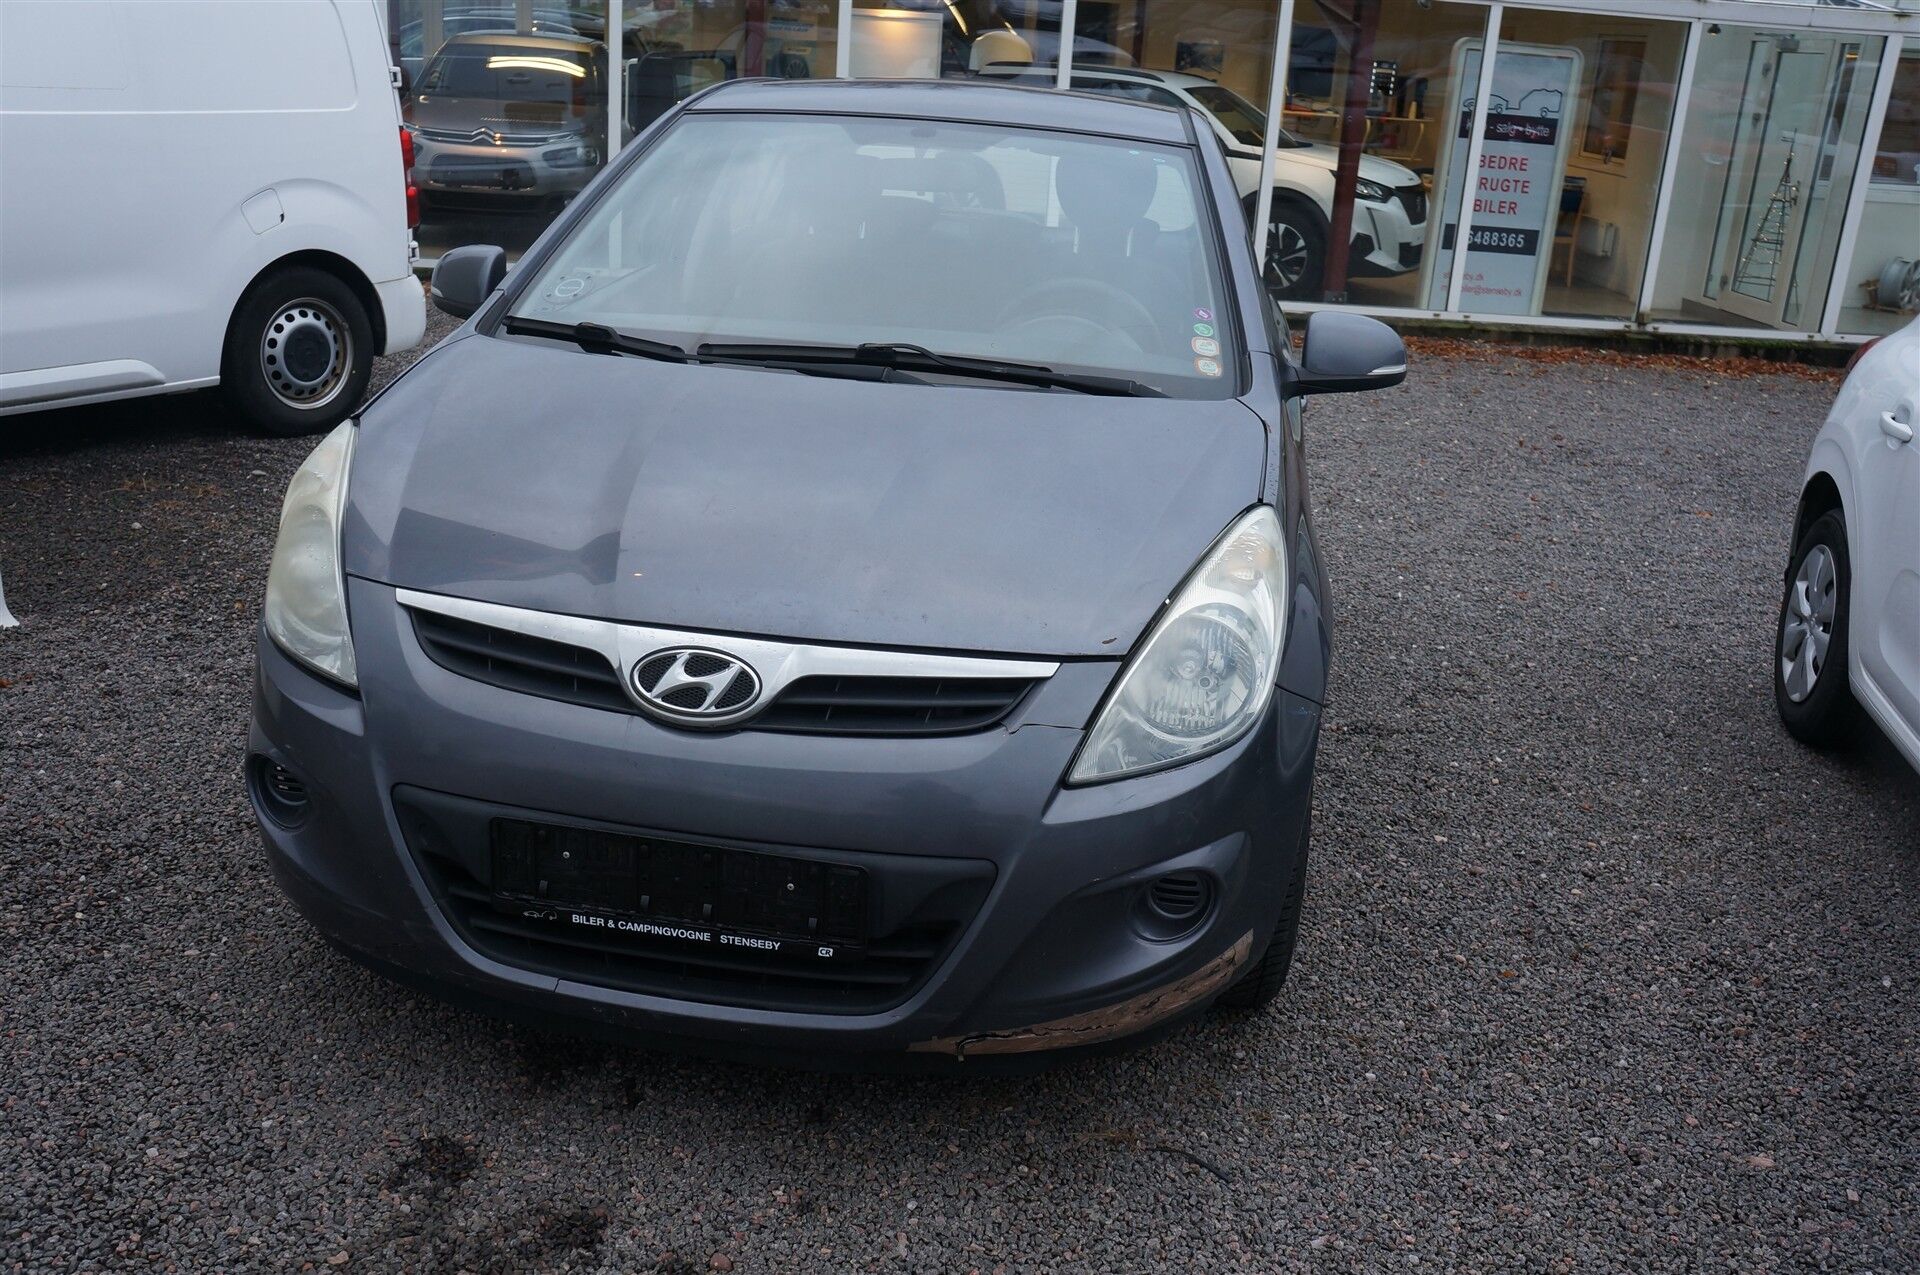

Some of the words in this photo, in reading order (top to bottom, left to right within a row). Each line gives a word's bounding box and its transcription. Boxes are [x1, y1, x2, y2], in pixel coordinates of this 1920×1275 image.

[1479, 154, 1529, 171] BEDRE
[1479, 176, 1530, 194] RUGTE
[1473, 199, 1518, 215] BILER
[1467, 230, 1526, 248] 6488365
[571, 914, 605, 927] BILER
[607, 919, 616, 929] &
[618, 920, 711, 942] CAMPINGVOGNE
[720, 934, 781, 951] STENSEBY
